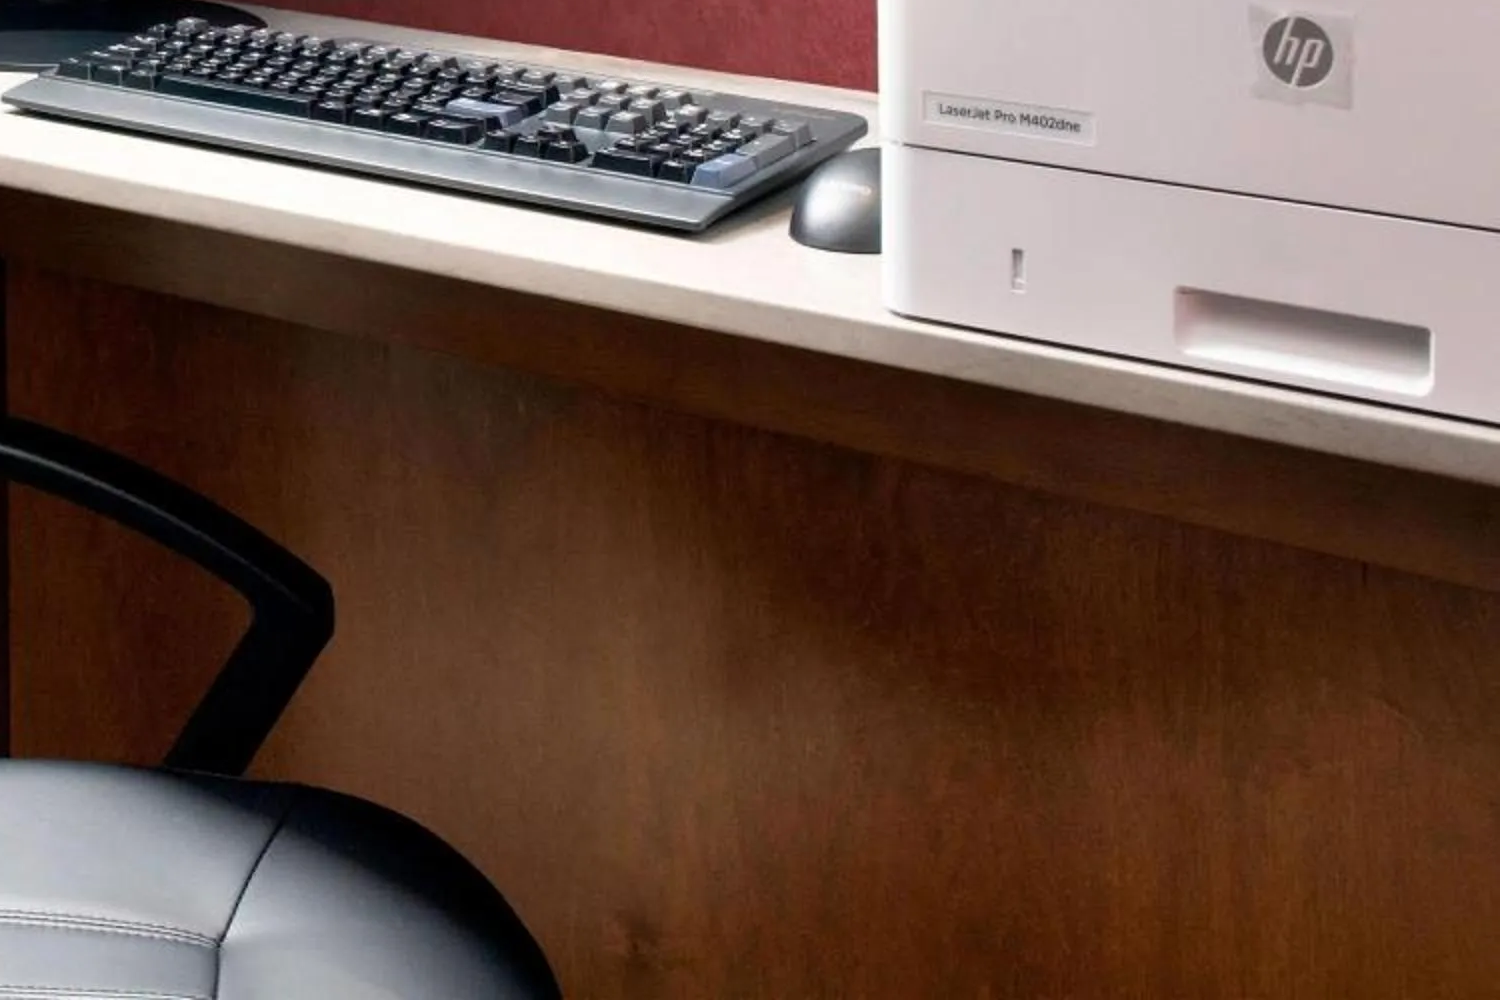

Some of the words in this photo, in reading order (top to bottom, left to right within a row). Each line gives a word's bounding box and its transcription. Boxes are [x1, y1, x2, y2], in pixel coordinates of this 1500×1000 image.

[939, 103, 990, 121] LaserJet
[994, 109, 1017, 124] Pro
[1019, 112, 1081, 133] M402dne
